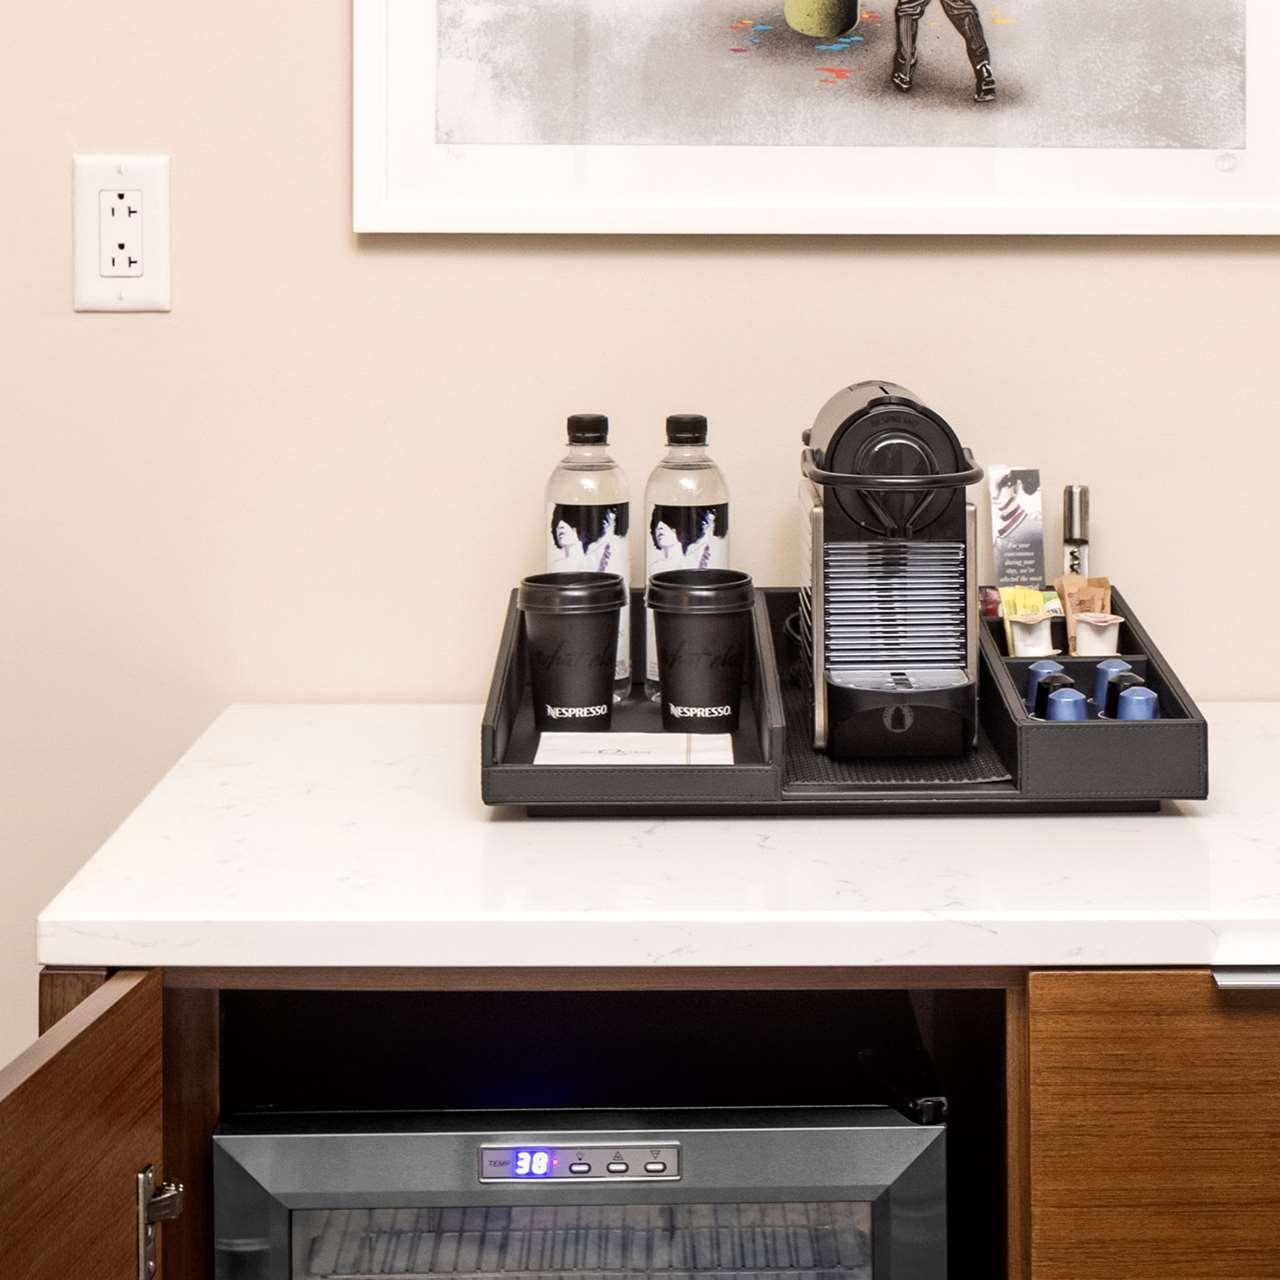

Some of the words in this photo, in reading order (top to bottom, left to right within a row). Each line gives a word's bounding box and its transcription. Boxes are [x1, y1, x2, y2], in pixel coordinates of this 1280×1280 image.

[545, 704, 607, 719] NESPRESSO
[668, 702, 731, 719] NESPRESSO
[515, 1151, 549, 1175] 38
